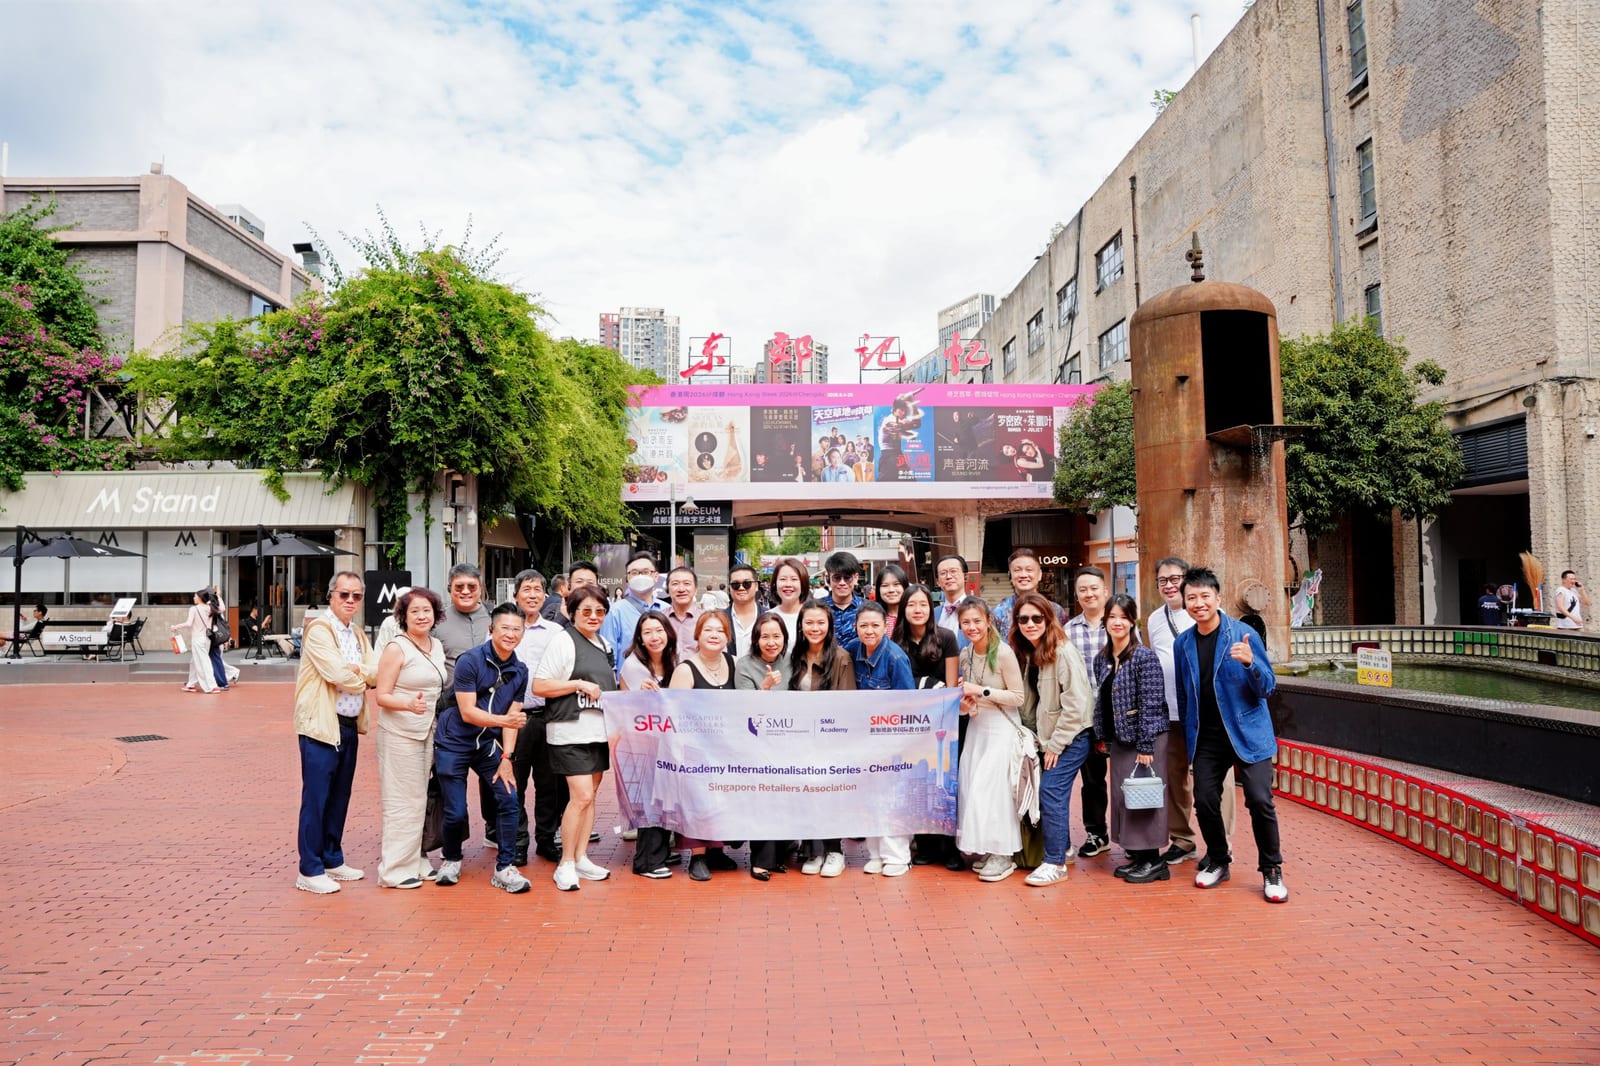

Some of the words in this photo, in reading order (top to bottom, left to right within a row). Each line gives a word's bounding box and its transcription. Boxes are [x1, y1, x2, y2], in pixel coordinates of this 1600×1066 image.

[943, 458, 989, 471] 声音河流
[86, 487, 121, 513] M
[131, 486, 221, 513] Stand
[680, 506, 721, 515] MUSEUM
[69, 634, 92, 643] Stand
[633, 714, 677, 734] SRA
[766, 717, 794, 729] SMU
[656, 760, 677, 772] SMU
[678, 764, 726, 775] Academy
[727, 764, 827, 775] Internationalisation
[828, 765, 861, 774] Series
[869, 761, 913, 773] Chengdu
[708, 783, 757, 792] Singapore
[758, 783, 801, 792] Retailers
[802, 783, 857, 792] Association
